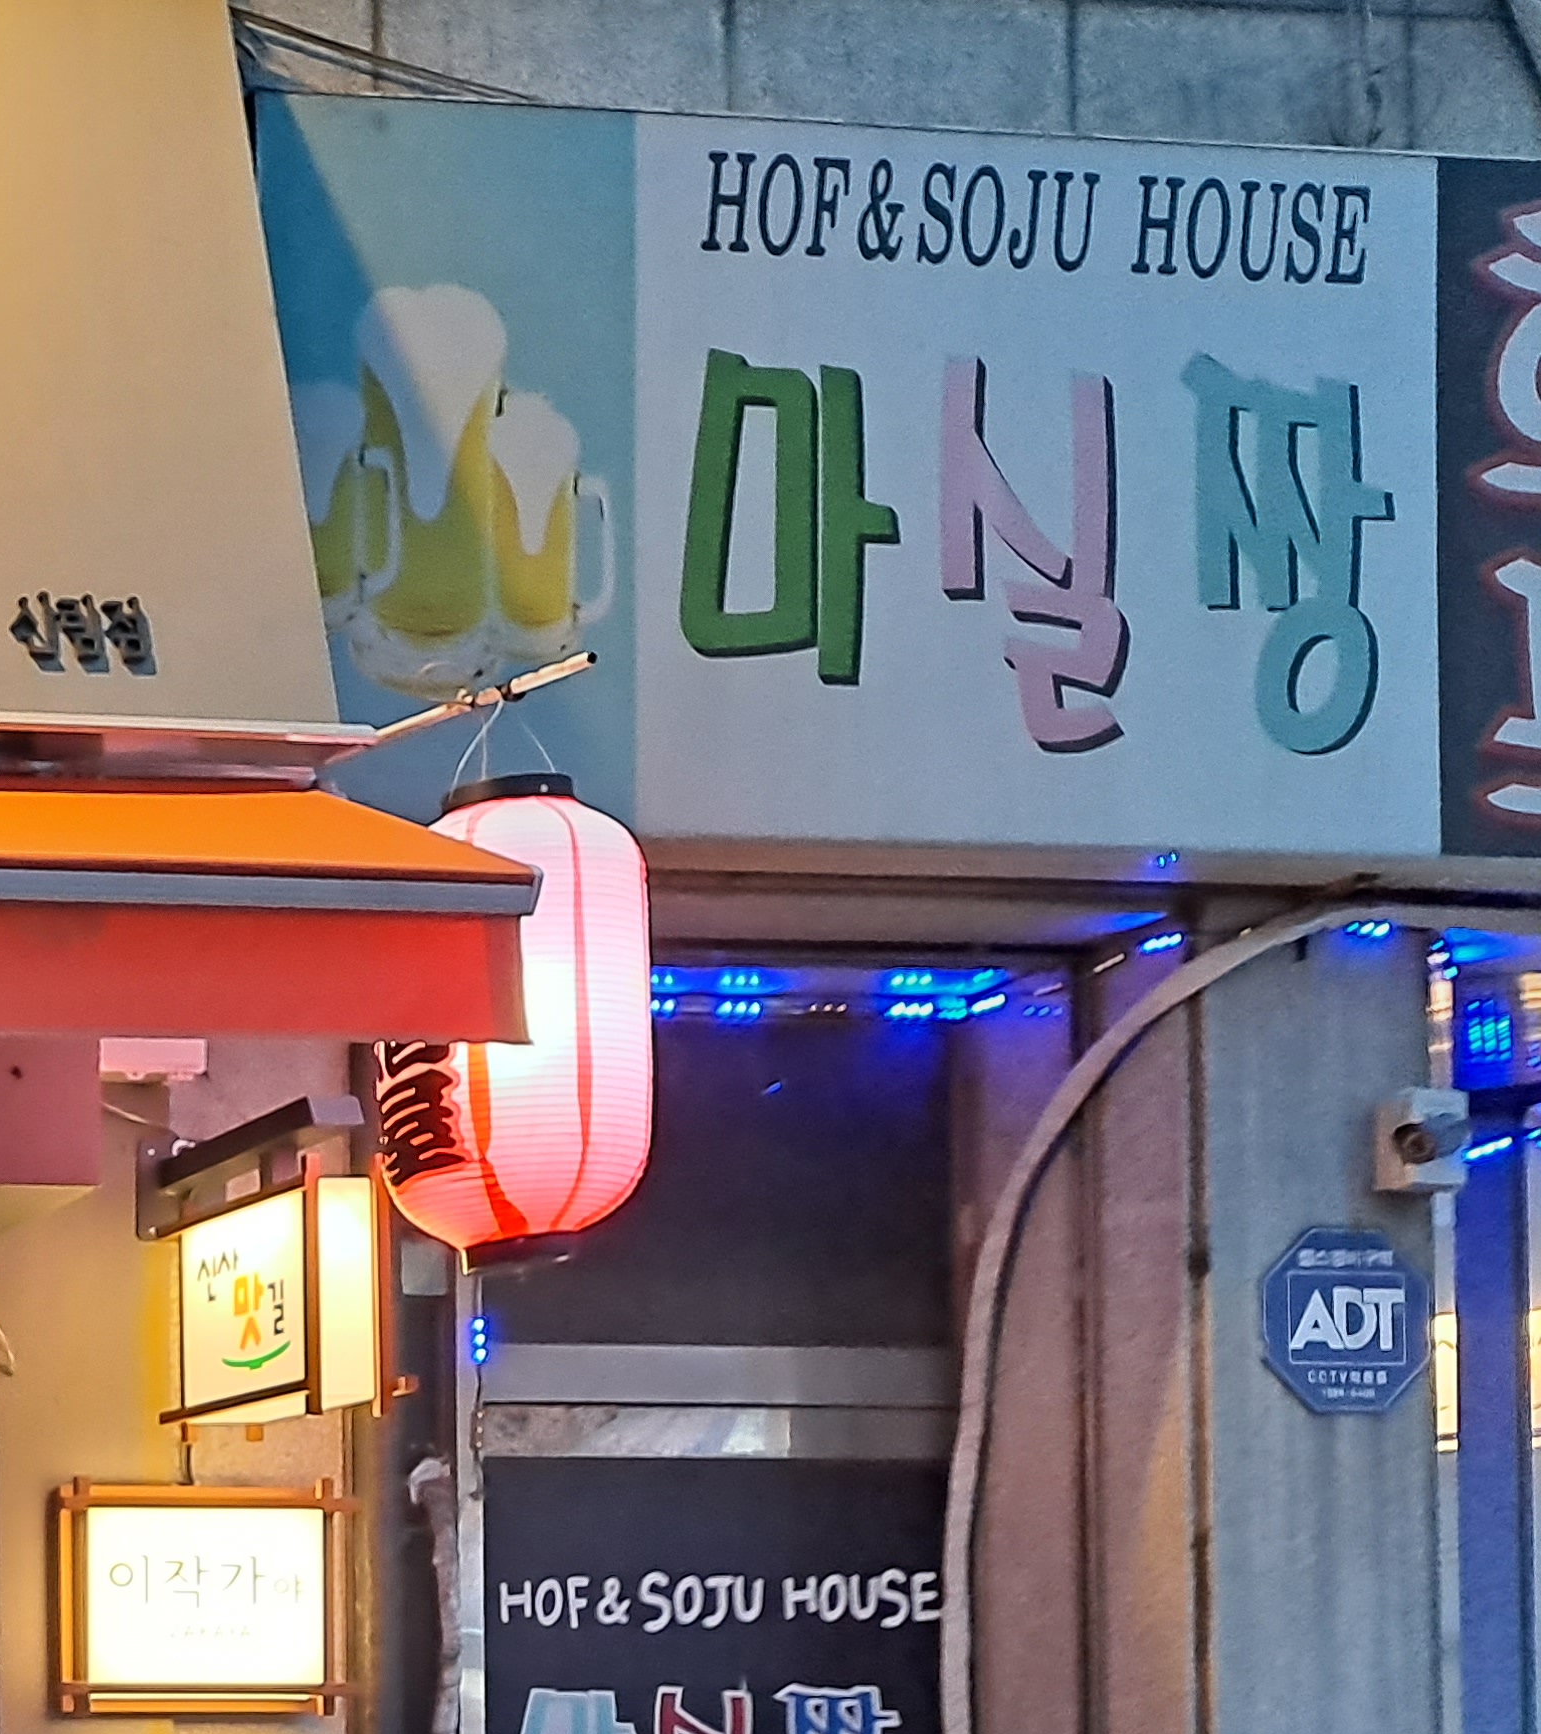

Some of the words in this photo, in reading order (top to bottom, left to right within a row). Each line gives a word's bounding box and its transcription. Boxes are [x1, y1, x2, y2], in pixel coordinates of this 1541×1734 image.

[1130, 175, 1372, 285] HOUSE
[679, 348, 1396, 756] 마실짱
[1290, 1285, 1406, 1351] ADT
[782, 1568, 941, 1629] HOUSE
